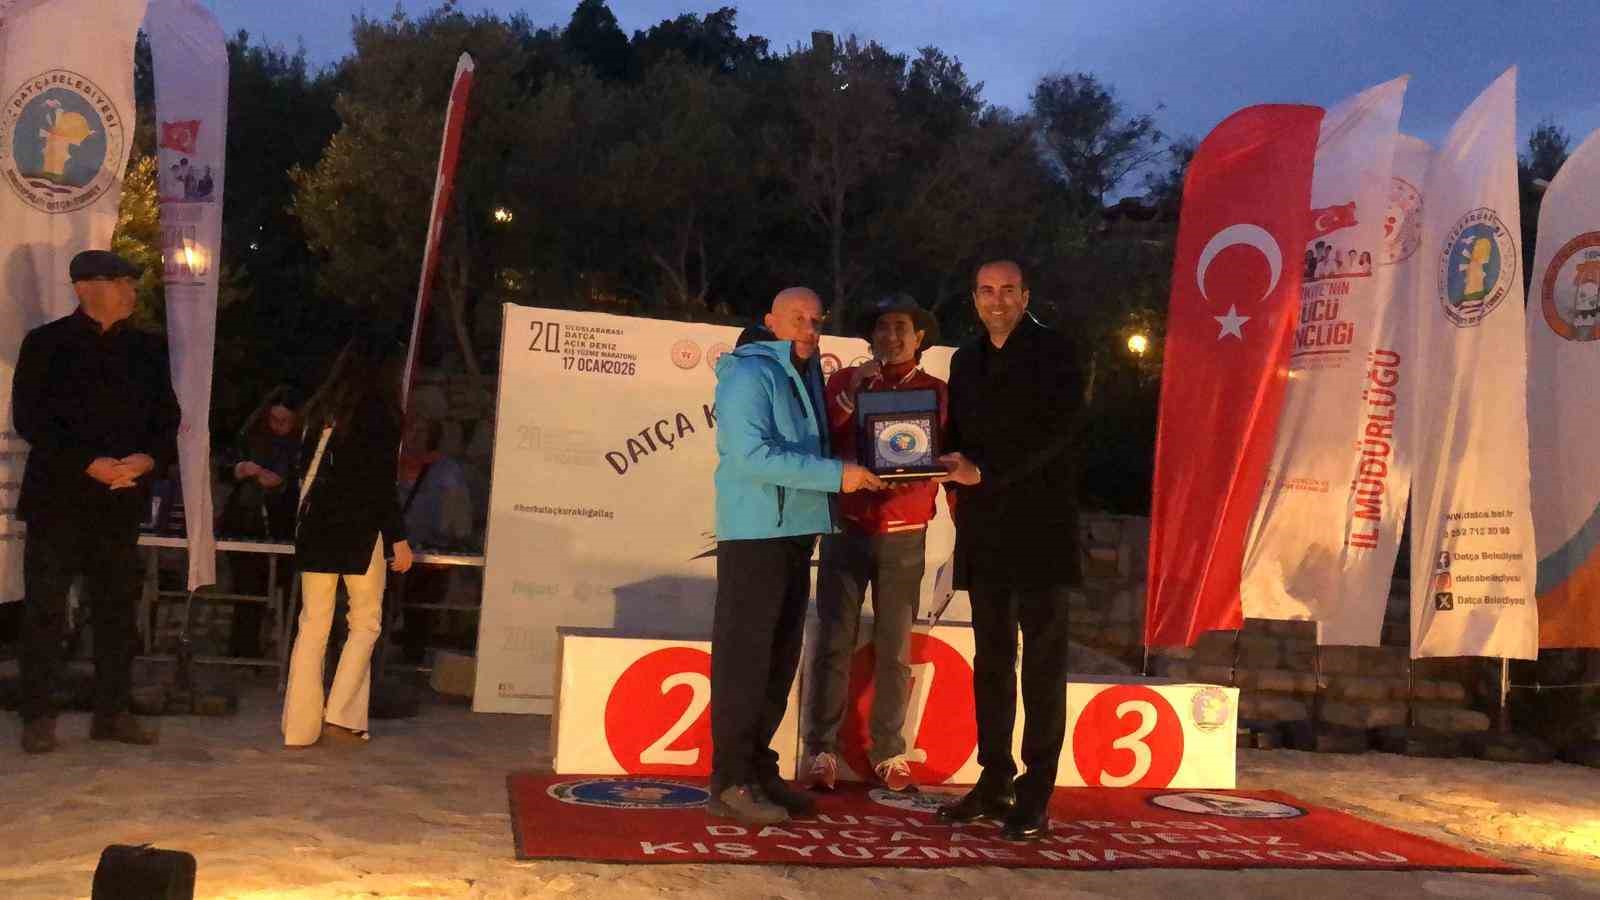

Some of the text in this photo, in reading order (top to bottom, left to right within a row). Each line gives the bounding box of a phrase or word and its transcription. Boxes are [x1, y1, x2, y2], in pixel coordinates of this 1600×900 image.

[1300, 299, 1340, 323] ÜCÜ
[528, 320, 560, 353] 20
[562, 356, 576, 370] 17
[604, 411, 695, 476] DATÇA
[640, 672, 711, 765] 2
[900, 661, 936, 764] 1
[1100, 700, 1158, 787] 3
[705, 824, 932, 843] DATÇA
[639, 839, 1409, 862] KIŞ YÜZME MARATONU
